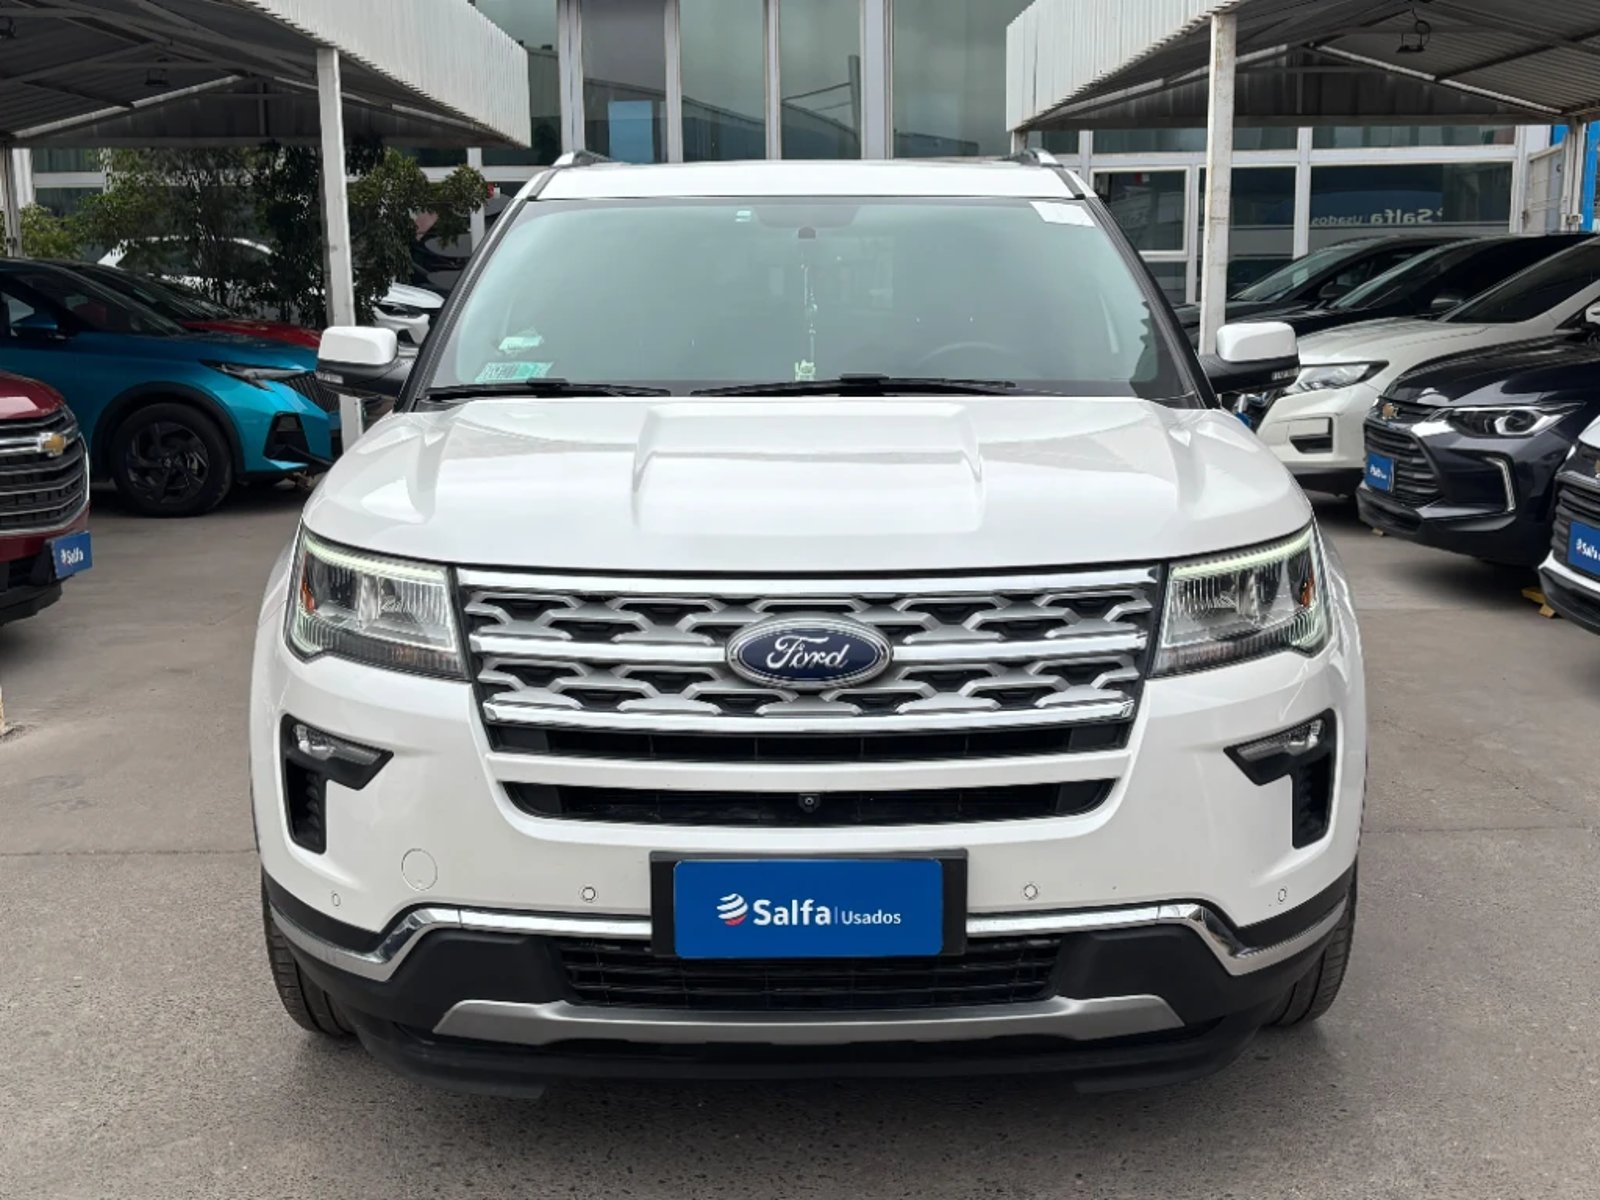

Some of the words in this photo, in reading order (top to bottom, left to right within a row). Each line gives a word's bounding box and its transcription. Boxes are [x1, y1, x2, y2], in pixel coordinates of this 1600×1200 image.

[766, 635, 850, 669] Ford
[753, 899, 831, 926] Salfa
[841, 909, 902, 924] Usados
